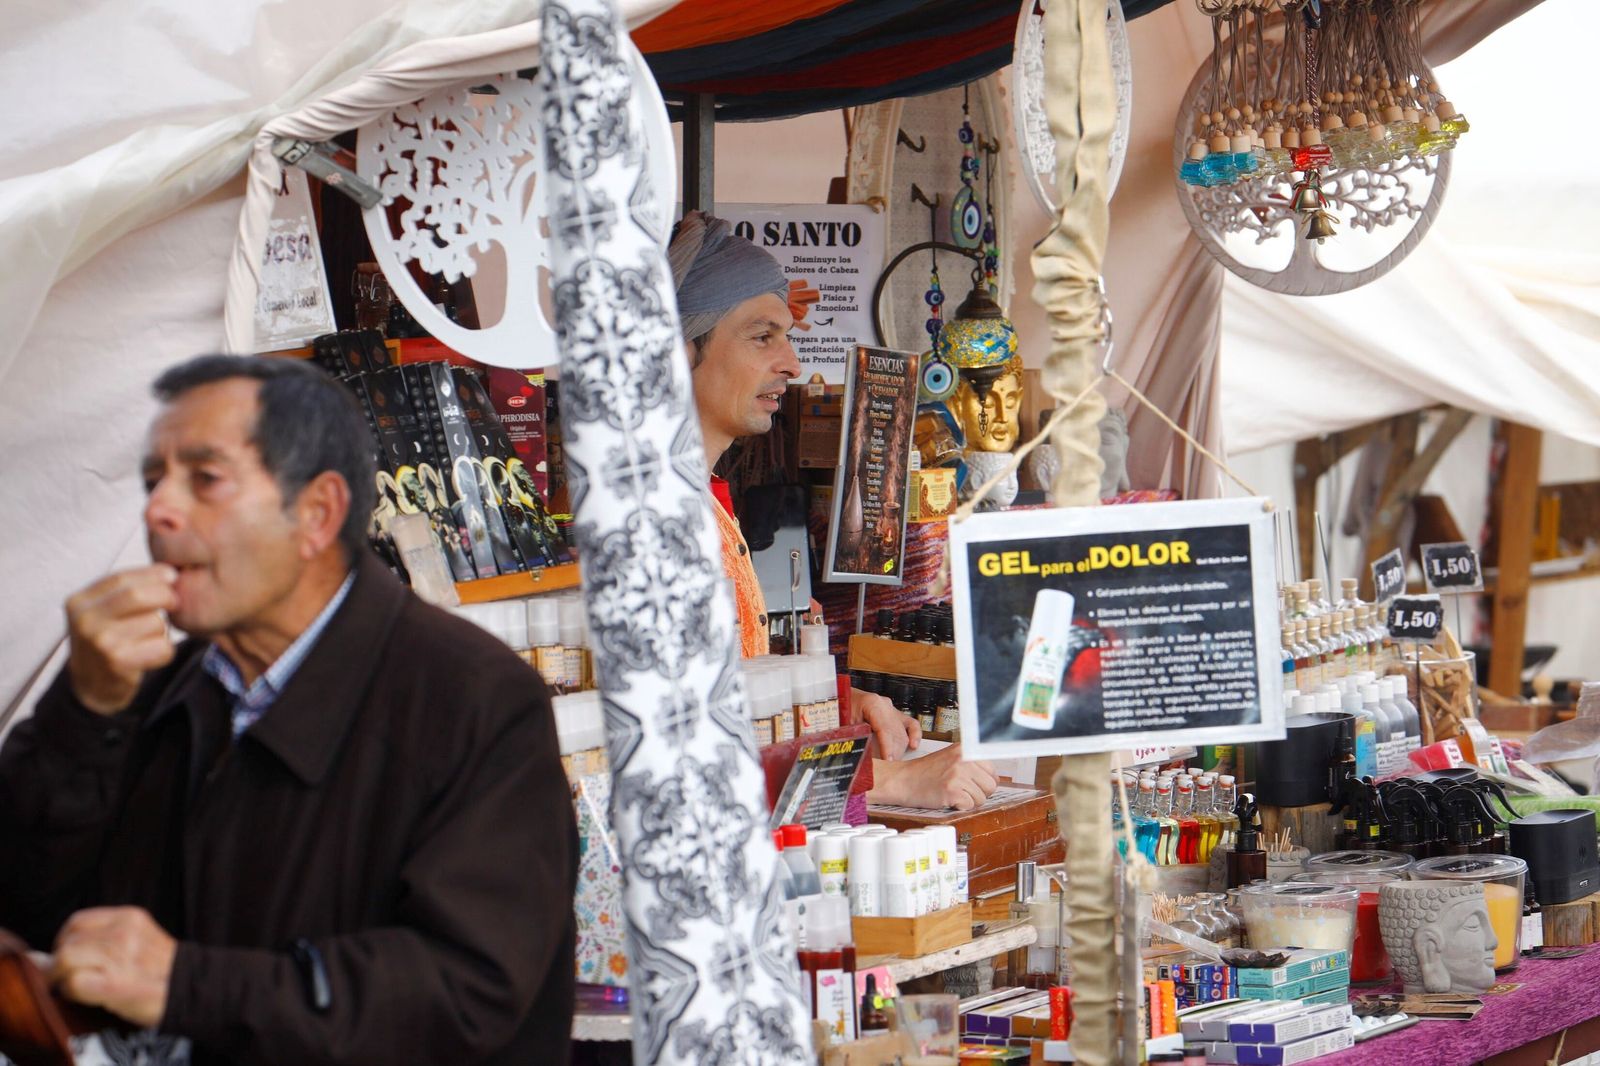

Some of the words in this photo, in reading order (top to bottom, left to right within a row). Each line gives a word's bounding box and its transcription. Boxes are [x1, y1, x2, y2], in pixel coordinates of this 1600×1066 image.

[763, 221, 862, 247] SANTO
[793, 256, 836, 264] Disminuye
[784, 266, 816, 274] Dolores
[818, 266, 828, 274] de
[830, 266, 859, 274] Cabeza
[819, 284, 856, 292] Limpieza
[850, 296, 855, 304] y
[868, 355, 904, 373] ESENCIAS
[978, 551, 1040, 576] GEL
[1041, 562, 1074, 578] para
[1076, 558, 1090, 573] el
[1090, 541, 1190, 570] DOLOR
[1432, 556, 1470, 578] 1,50
[1378, 566, 1400, 592] 1,50
[1222, 600, 1236, 609] por
[1394, 610, 1436, 630] 1,50
[1099, 640, 1108, 648] Es
[1112, 639, 1123, 648] un
[1126, 637, 1164, 646] producto
[1199, 633, 1211, 642] de
[1214, 631, 1252, 640] extractos
[1100, 648, 1144, 658] naturales
[1147, 646, 1170, 655] para
[1168, 665, 1195, 673] efecto
[827, 740, 854, 755] DOLOR
